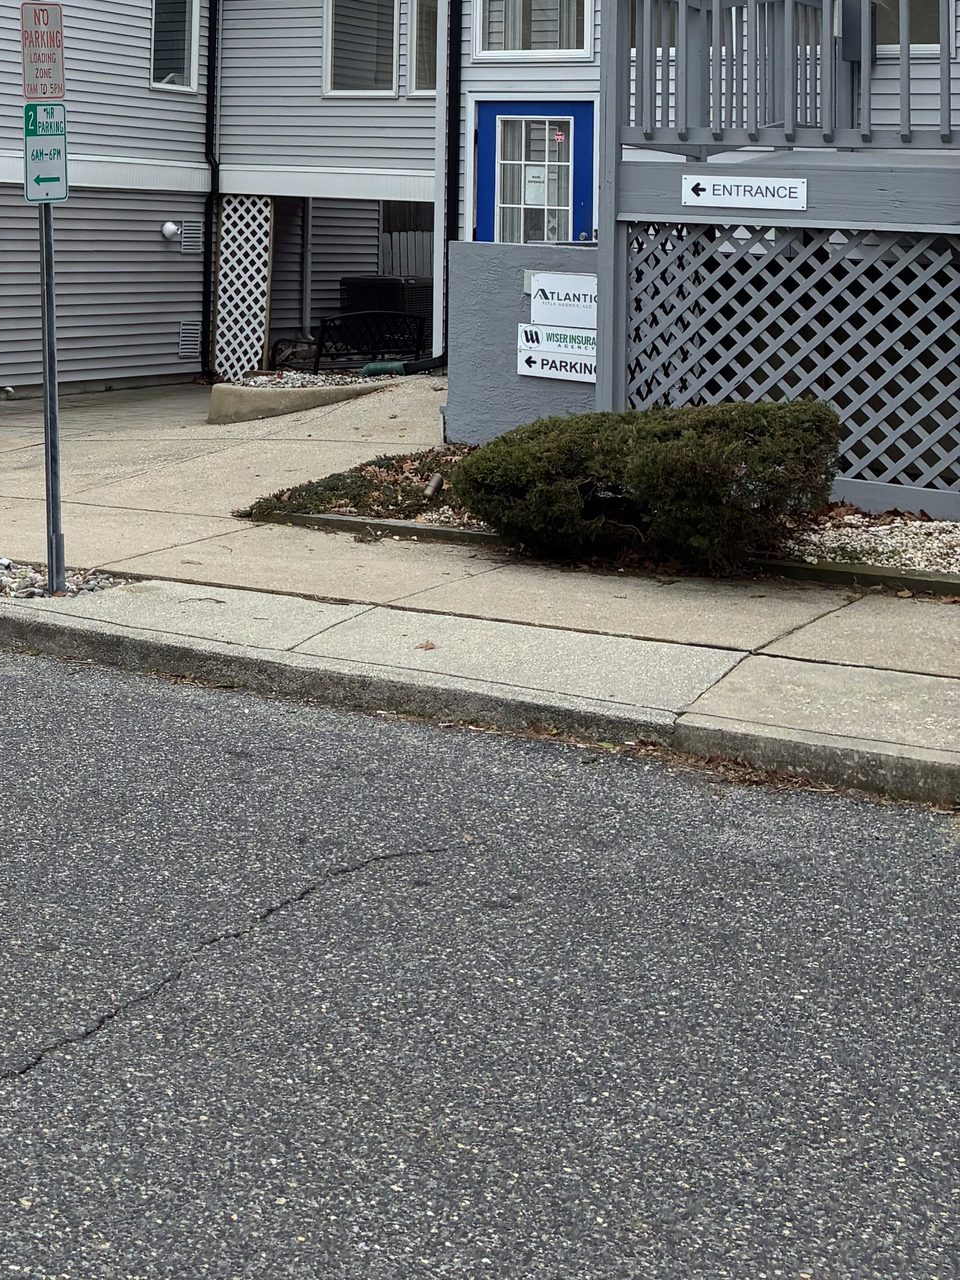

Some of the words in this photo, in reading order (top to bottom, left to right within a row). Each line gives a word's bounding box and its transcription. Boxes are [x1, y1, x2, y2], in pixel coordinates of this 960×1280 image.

[33, 8, 49, 26] NO
[23, 30, 62, 48] PARKING
[30, 52, 56, 64] LOADING
[35, 67, 52, 79] ZONE
[40, 83, 48, 94] TO
[28, 111, 35, 130] 2
[46, 107, 55, 120] HR
[38, 121, 64, 134] PARKING
[712, 183, 798, 199] ENTRANCE
[540, 358, 597, 375] PARKIN
